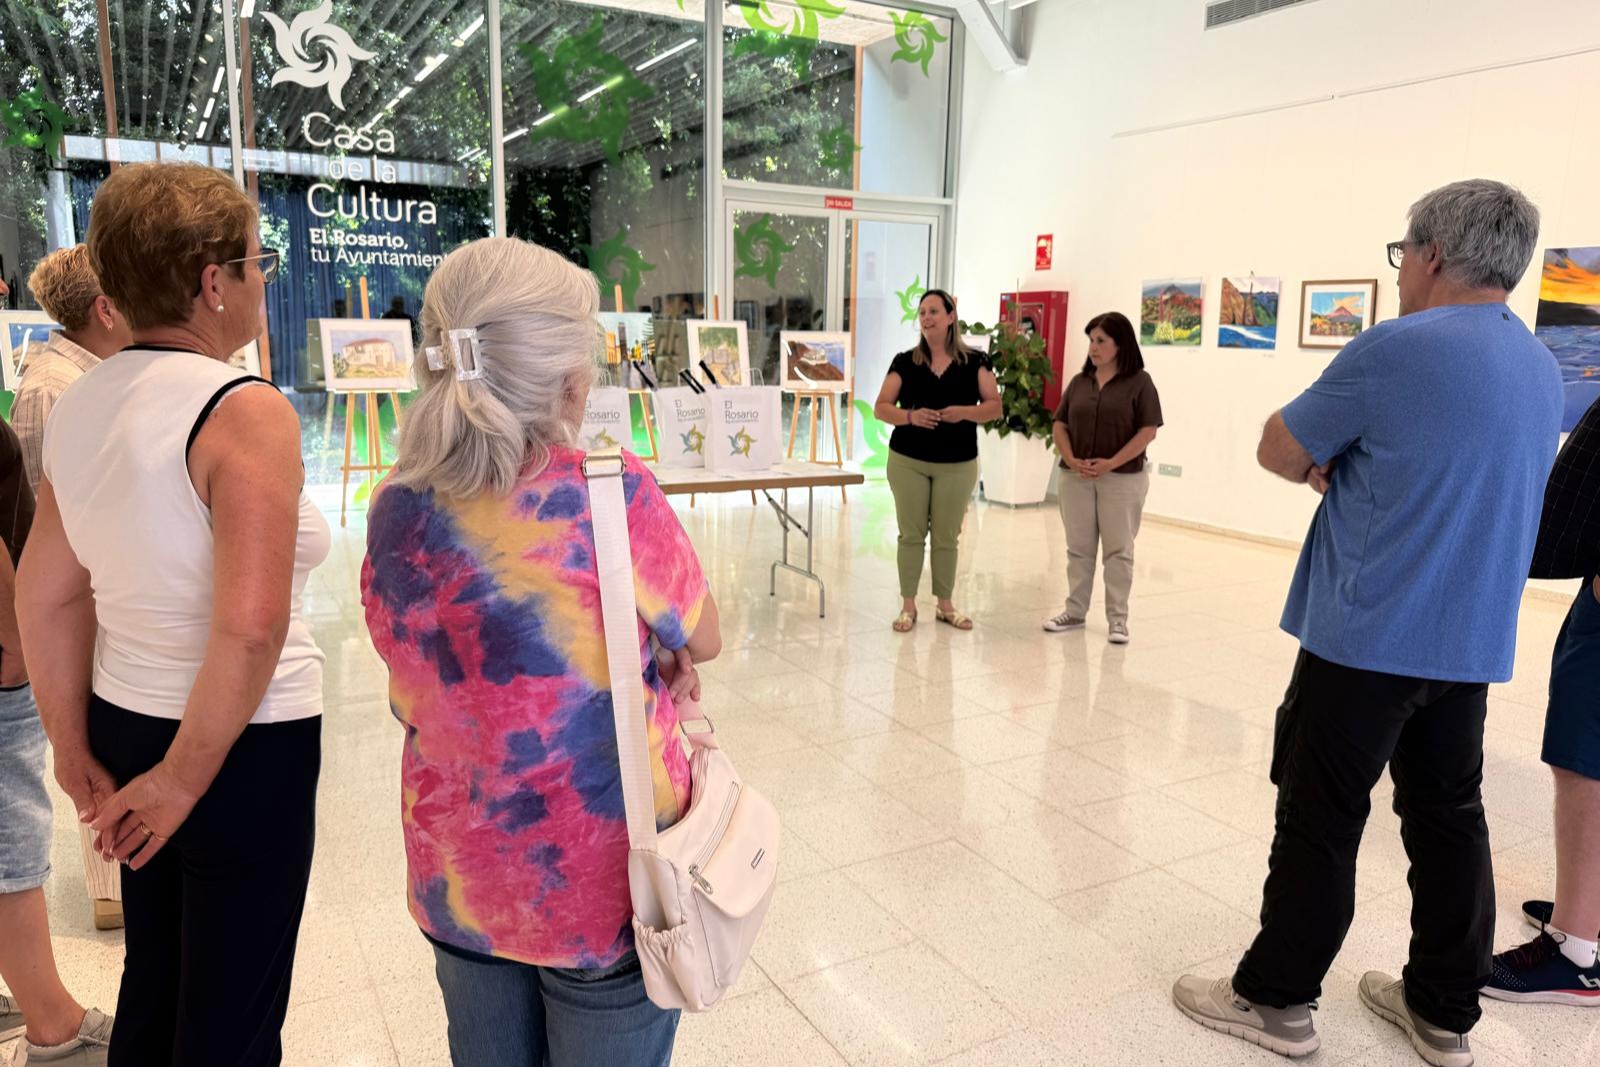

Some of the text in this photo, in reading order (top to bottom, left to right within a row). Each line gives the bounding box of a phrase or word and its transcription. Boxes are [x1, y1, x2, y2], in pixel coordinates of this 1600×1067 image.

[303, 112, 395, 153] Casa
[329, 154, 396, 184] de la
[307, 183, 437, 224] Cultura
[309, 228, 409, 249] El Rosario,
[311, 249, 330, 263] tu
[674, 399, 682, 409] El
[724, 400, 733, 409] El
[585, 410, 621, 420] Rosario
[676, 408, 706, 418] Rosario
[725, 410, 759, 420] Rosario
